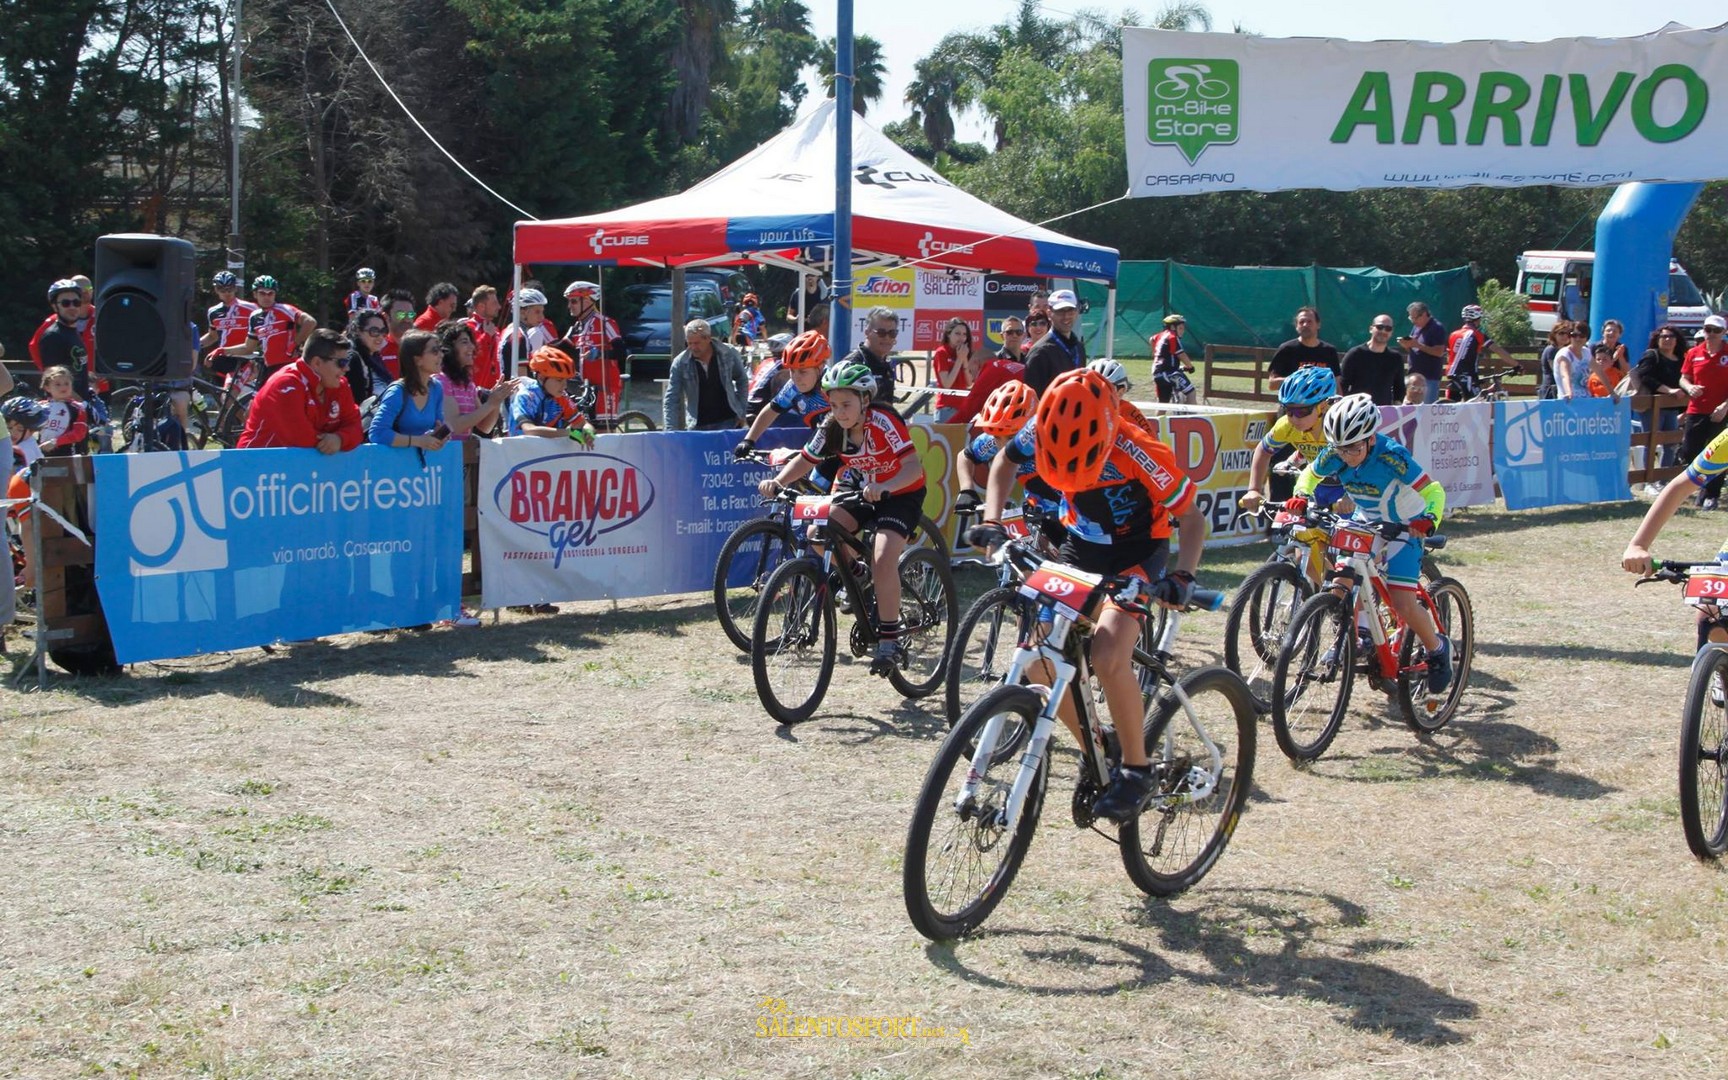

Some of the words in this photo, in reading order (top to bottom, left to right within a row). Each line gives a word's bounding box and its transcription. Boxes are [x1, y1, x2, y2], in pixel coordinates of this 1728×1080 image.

[1155, 100, 1232, 116] m-Bike
[1330, 63, 1709, 147] ARRIVO
[1155, 118, 1232, 137] Store
[602, 236, 649, 247] CUBE
[930, 241, 974, 255] CUBE
[704, 451, 721, 466] Via
[1221, 450, 1254, 471] VANTA
[701, 473, 735, 488] 73042
[229, 465, 442, 520] officinetessili
[509, 467, 640, 523] BRANCA
[702, 496, 720, 511] Tel.
[721, 499, 728, 510] e
[729, 495, 749, 510] Fax:
[549, 491, 600, 569] gel
[676, 518, 713, 535] E-mail:
[1343, 534, 1362, 550] 16
[273, 547, 293, 563] via
[344, 539, 412, 557] Casarano
[1043, 577, 1076, 597] 89
[1700, 579, 1727, 595] 39
